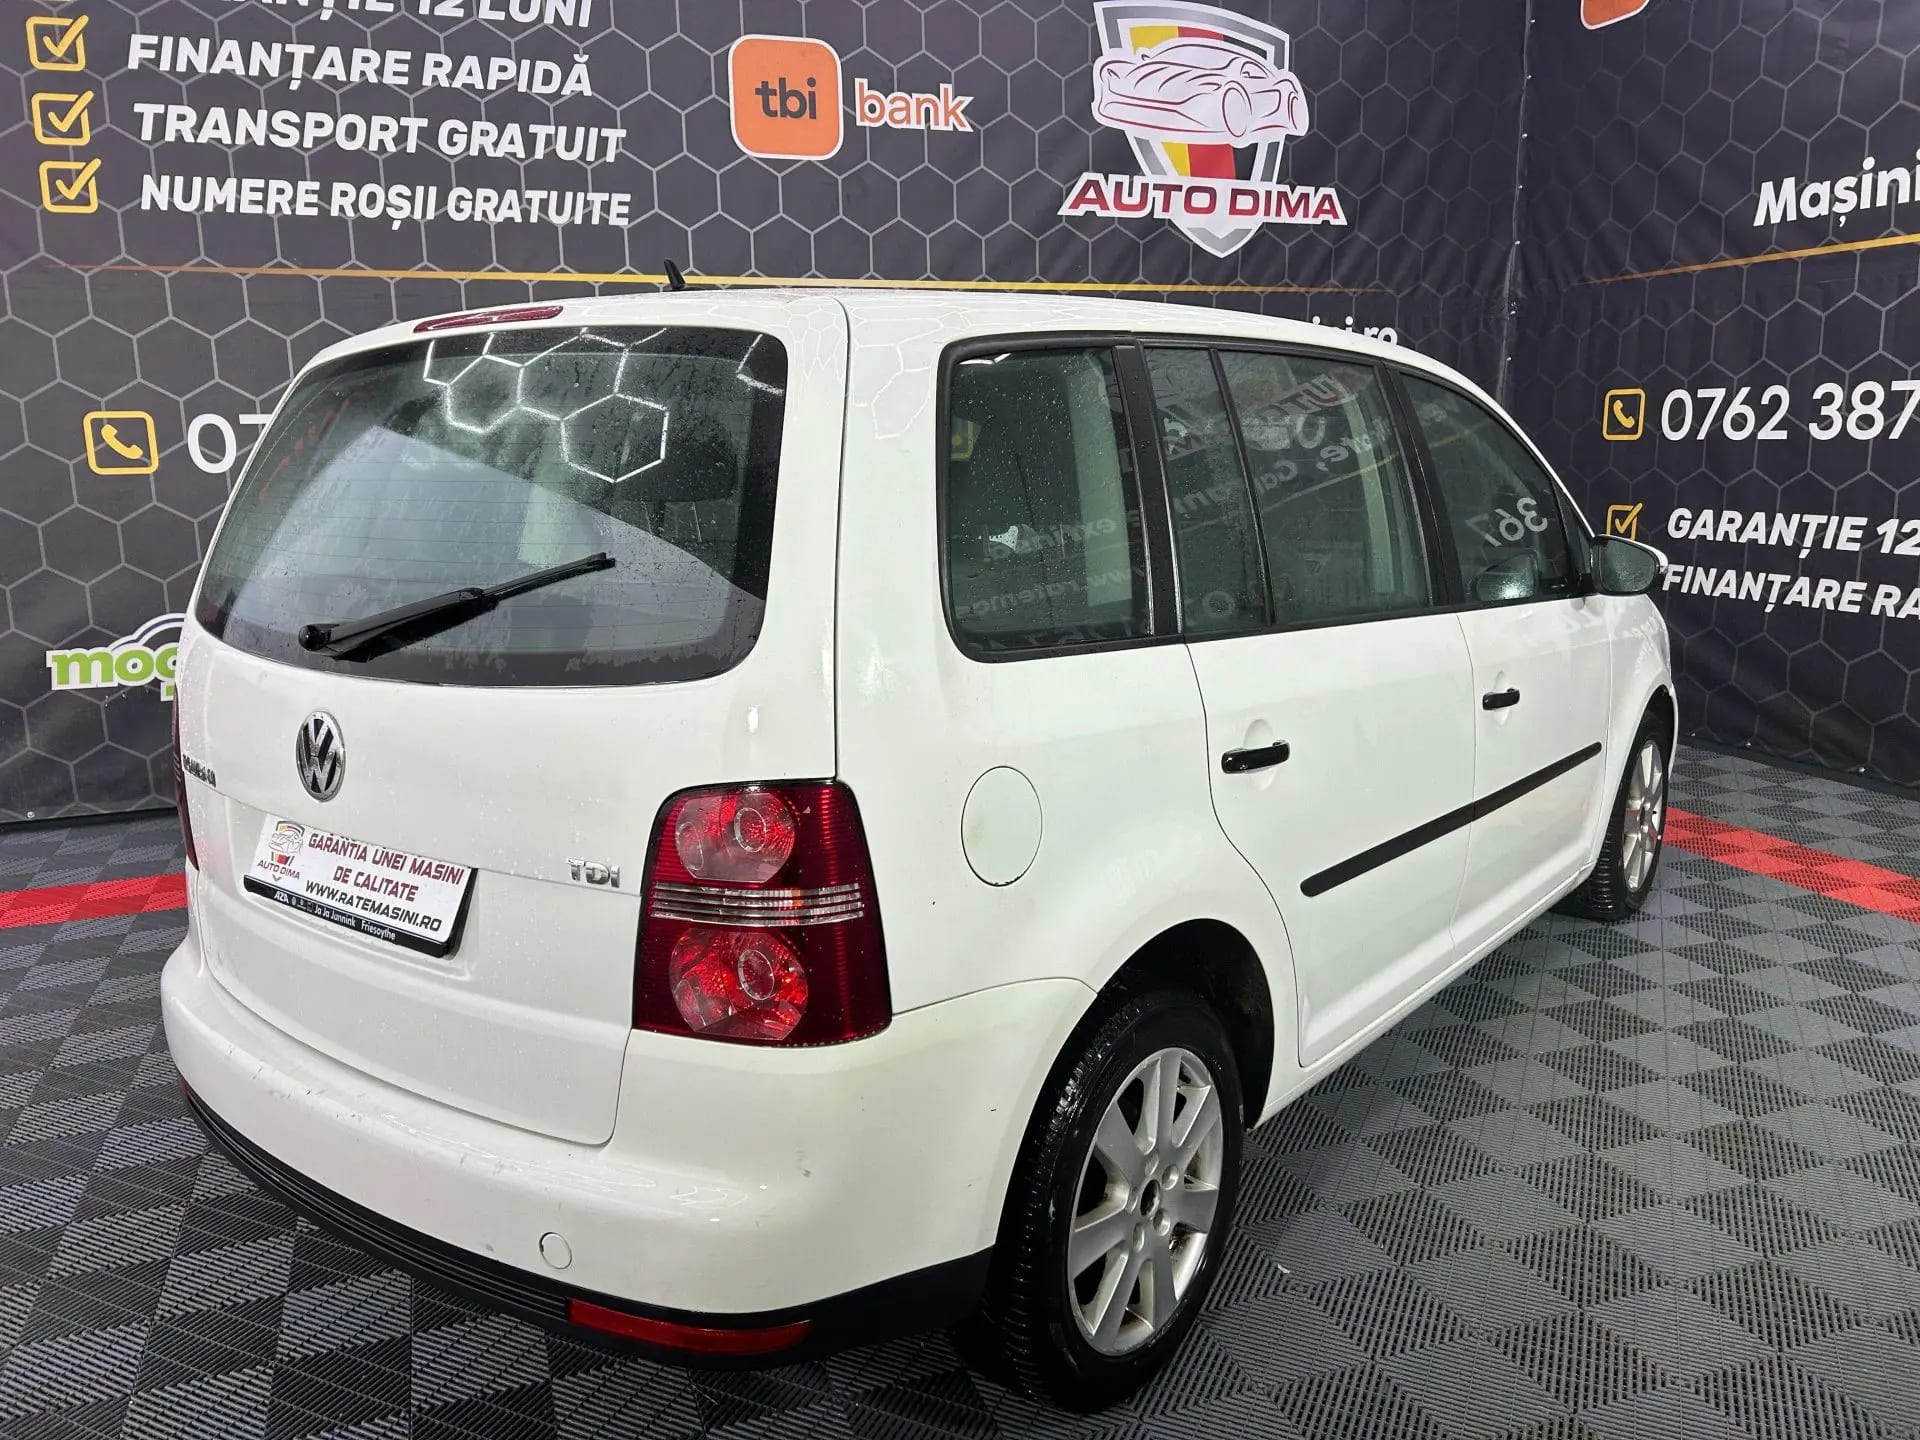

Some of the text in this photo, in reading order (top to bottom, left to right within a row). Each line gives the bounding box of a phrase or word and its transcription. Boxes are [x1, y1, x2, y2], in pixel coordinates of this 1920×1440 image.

[128, 34, 592, 96] FINANȚARE RAPIDĂ
[755, 77, 971, 130] tbi bank
[133, 102, 627, 163] TRANSPORT GRATUIT
[141, 174, 631, 231] NUMERE ROȘII GRATUITE
[1067, 179, 1341, 220] AUTO DIMA
[1661, 384, 1790, 441] 0762
[1667, 507, 1920, 559] GARANȚIE 12
[1662, 563, 1868, 613] FINANȚARE
[256, 859, 300, 880] AUTO DIMA
[308, 832, 464, 885] GARANTIA UNEI MASINI
[333, 865, 419, 901] DE CALITATE
[567, 857, 620, 888] TDI
[306, 879, 442, 932] WWW.RATEMASINI.RO
